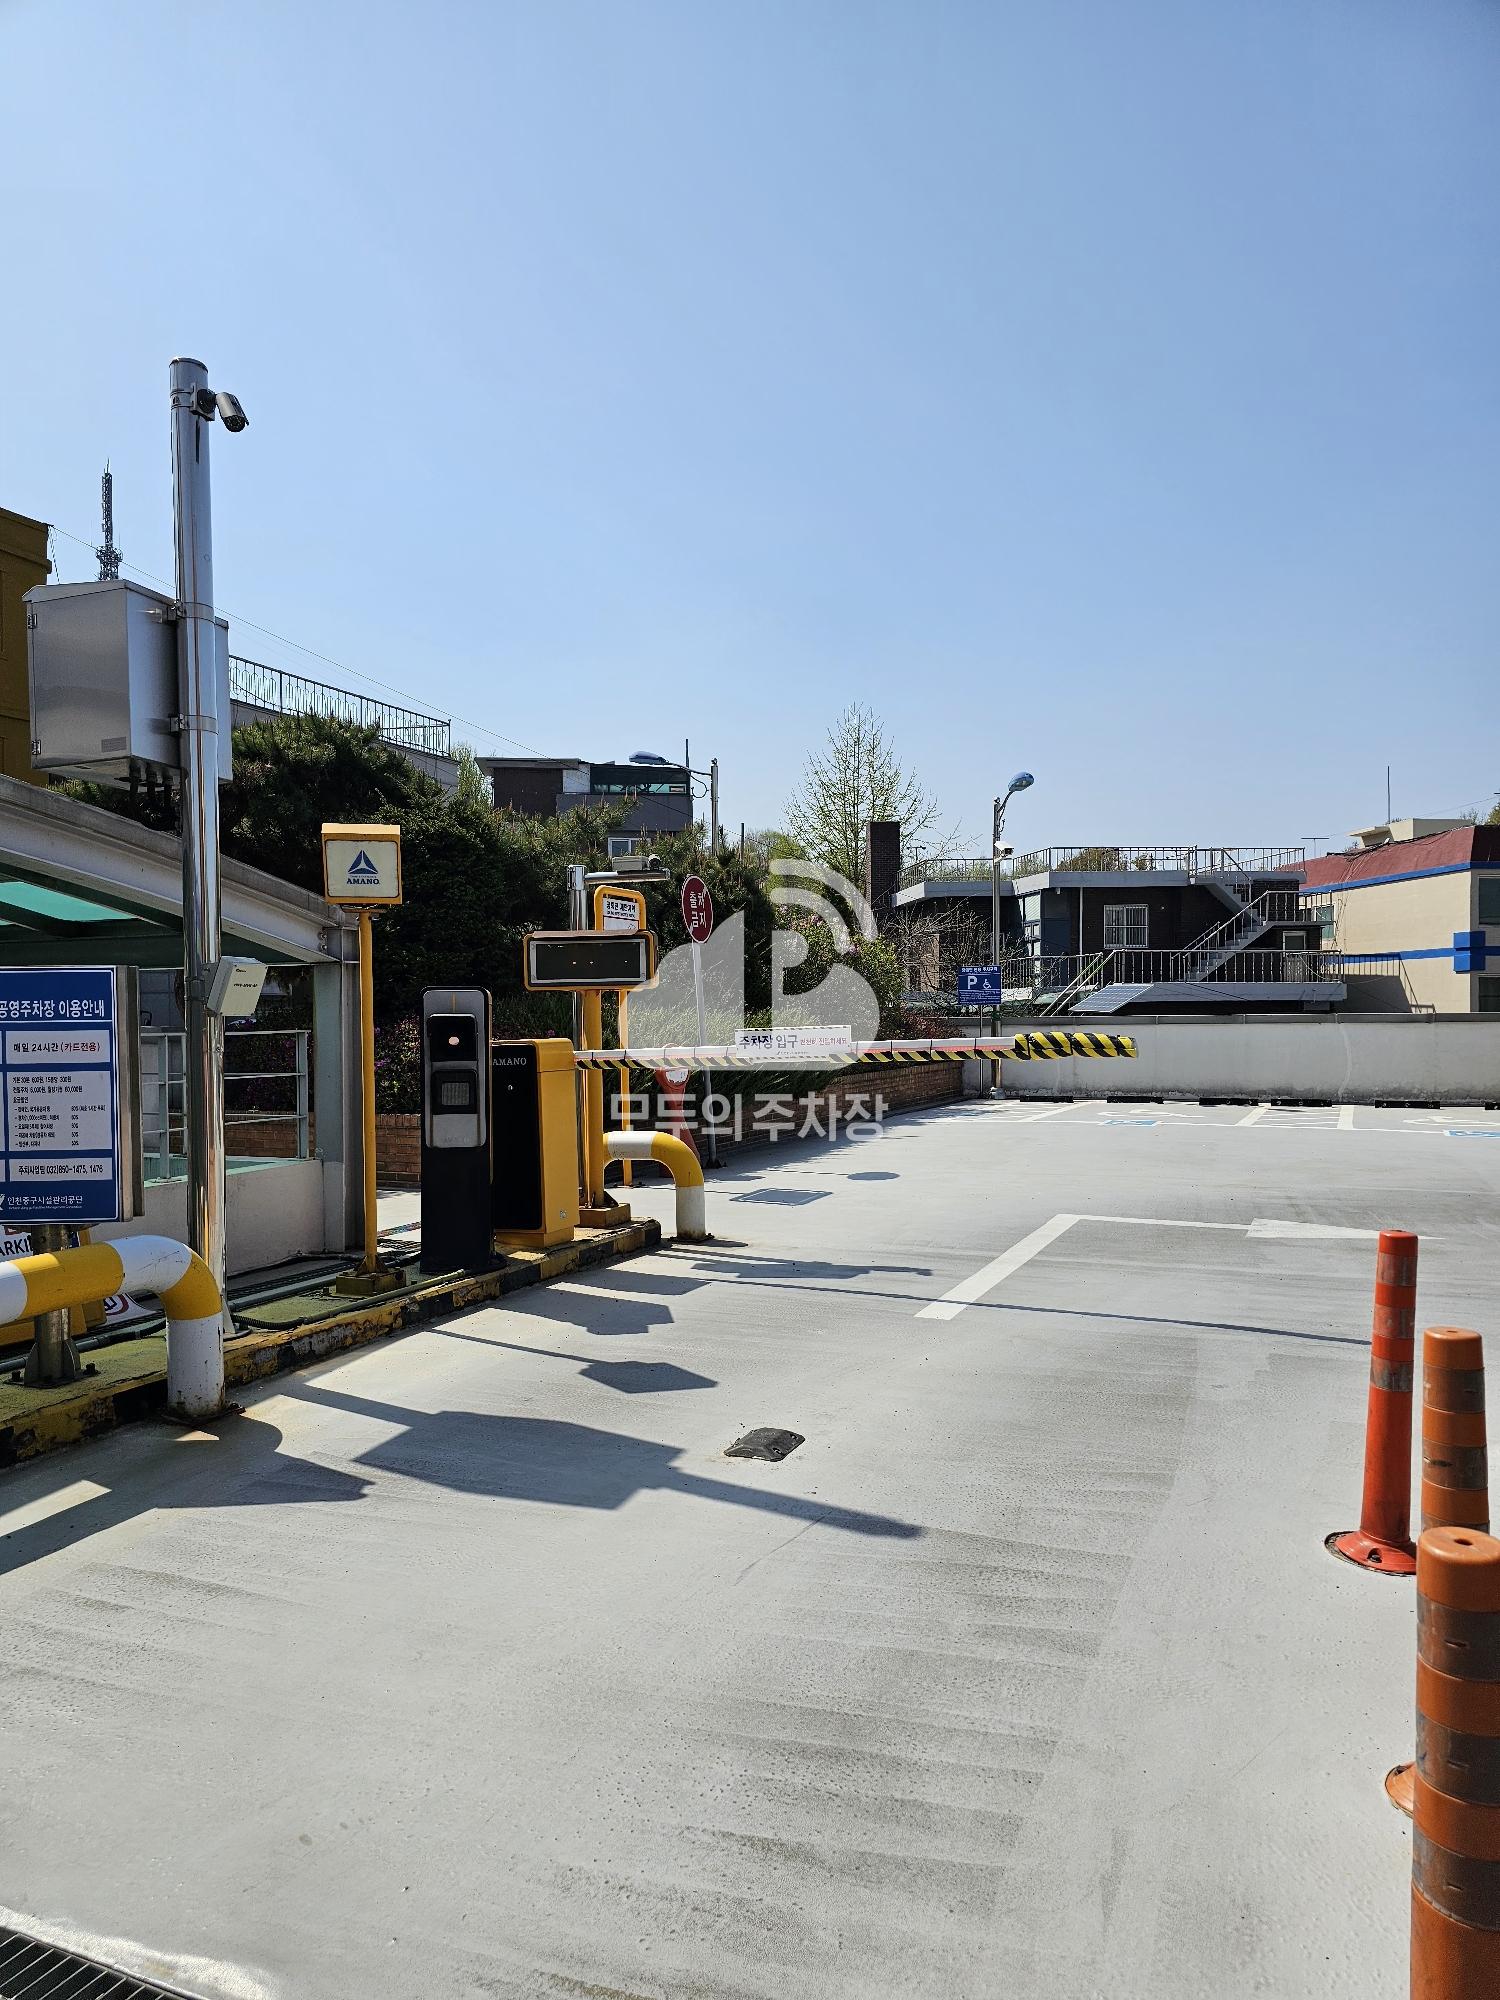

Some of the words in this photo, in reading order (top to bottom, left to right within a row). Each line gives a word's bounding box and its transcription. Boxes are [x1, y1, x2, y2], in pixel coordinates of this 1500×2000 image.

[967, 975, 978, 990] P
[58, 999, 105, 1018] 이용안내
[13, 1042, 29, 1053] 매일
[60, 1041, 101, 1053] (카드전용)
[739, 1034, 774, 1050] 주차장
[775, 1034, 799, 1049] 입구
[492, 1057, 528, 1066] AMANO
[7, 1195, 84, 1206] 인천중구시설관리공단
